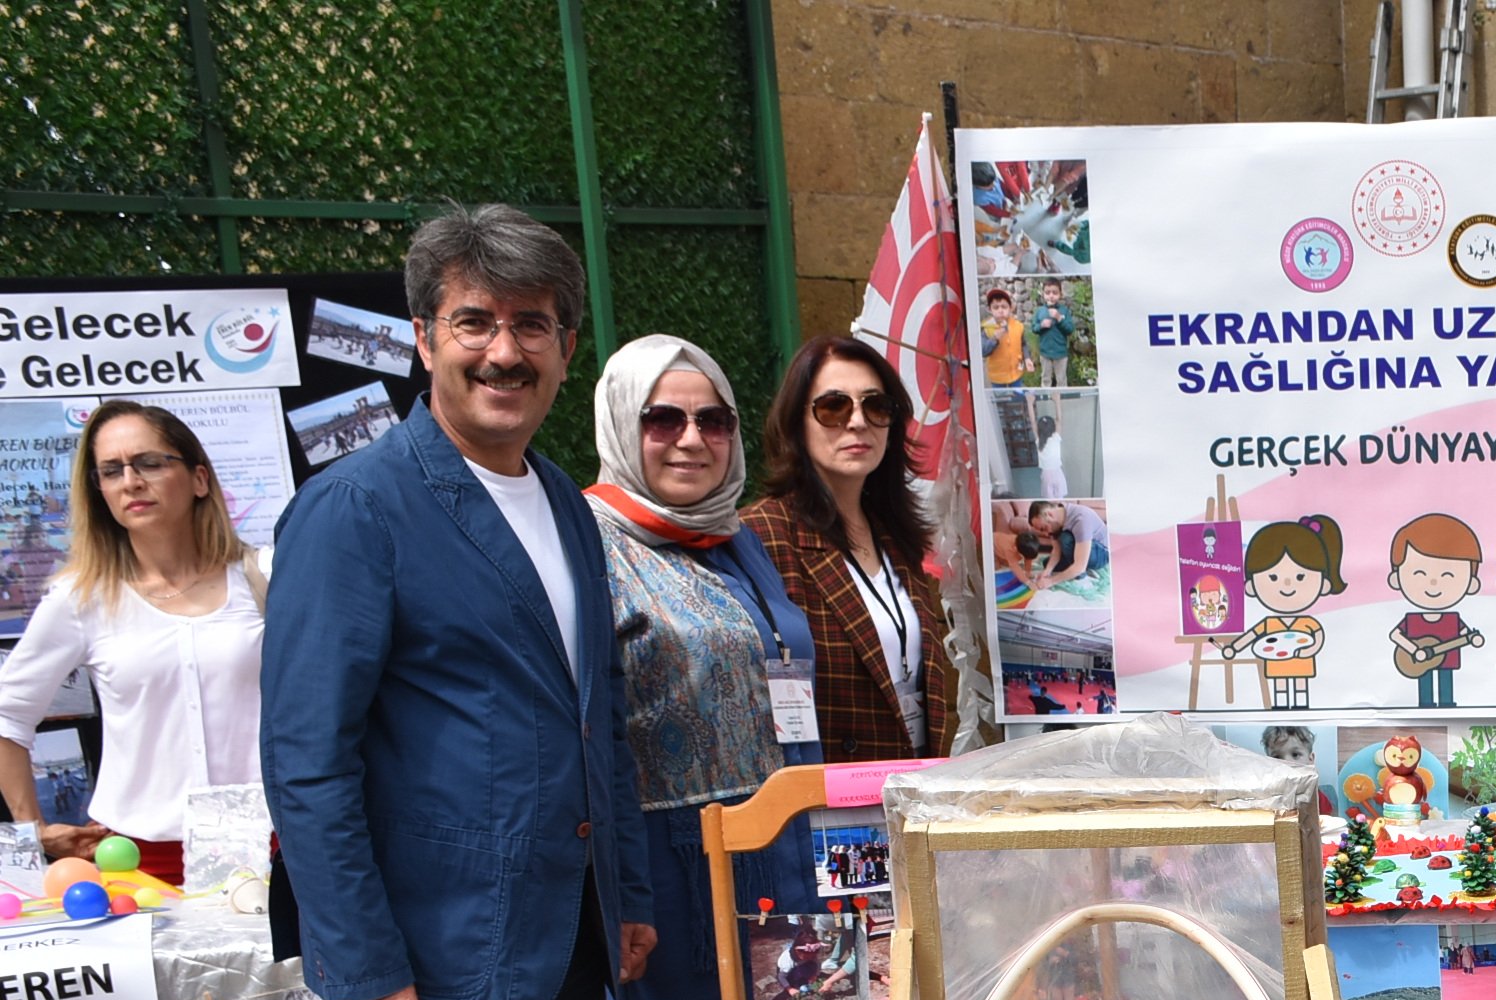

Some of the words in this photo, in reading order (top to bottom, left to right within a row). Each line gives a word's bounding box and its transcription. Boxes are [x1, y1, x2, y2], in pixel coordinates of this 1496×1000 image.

[1147, 309, 1415, 346] EKRANDAN
[22, 351, 204, 388] Gelecek
[1177, 351, 1441, 394] SAĞLIĞINA
[187, 418, 229, 428] AOKULU
[1209, 433, 1349, 477] GERÇEK
[4, 938, 80, 951] ERKEZ
